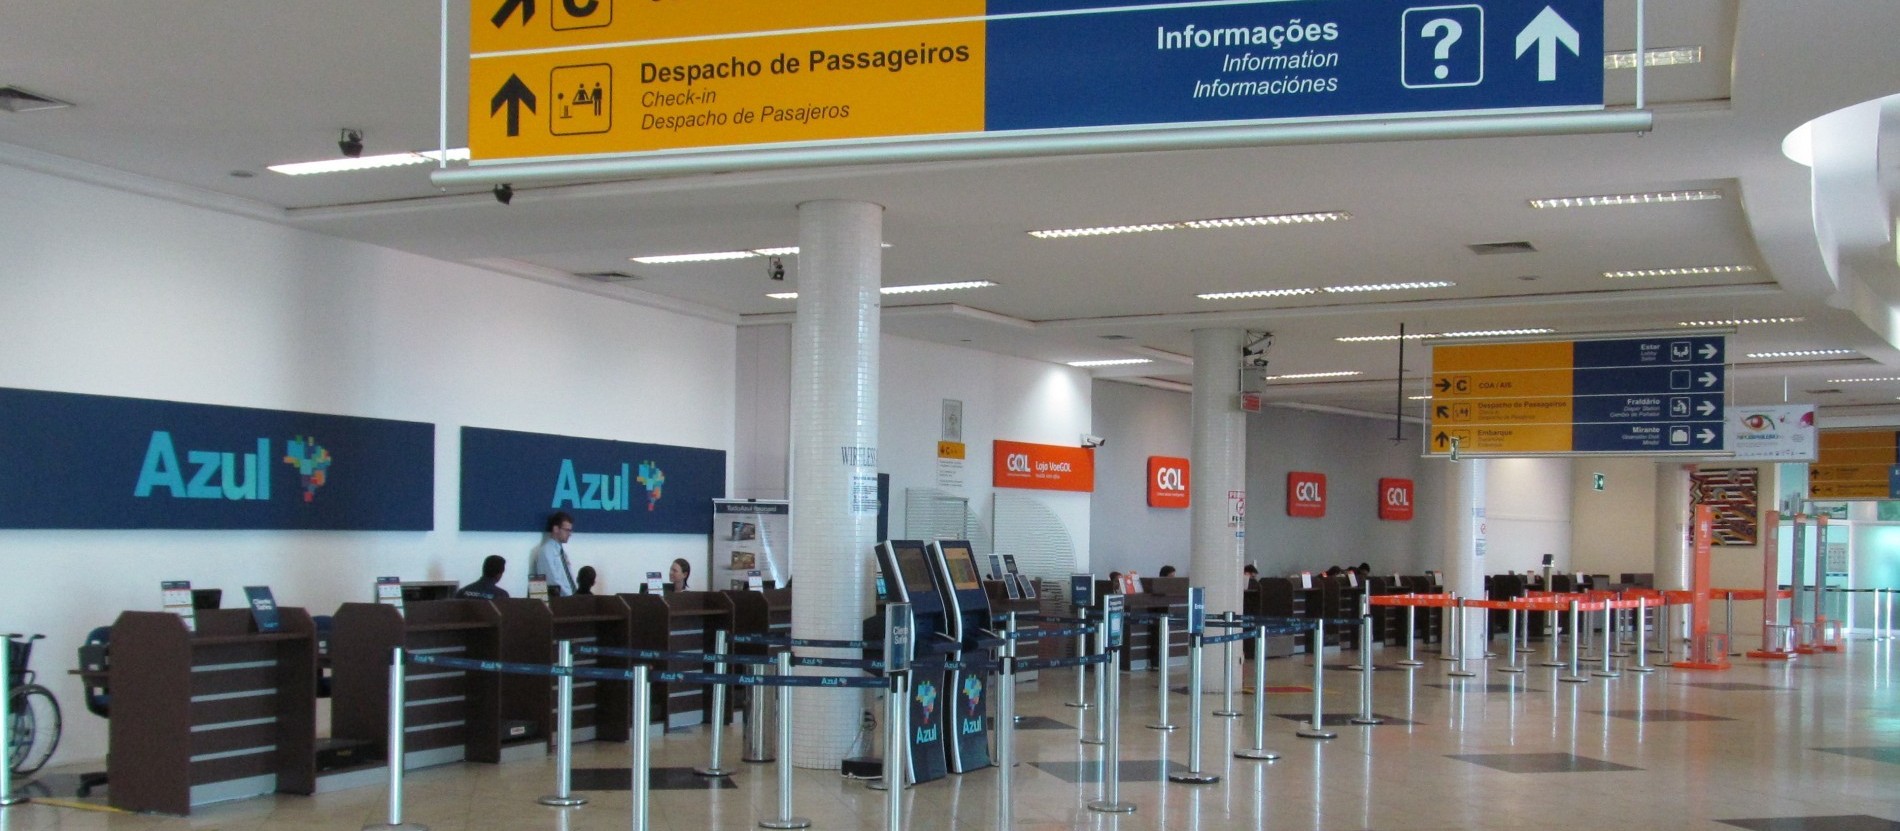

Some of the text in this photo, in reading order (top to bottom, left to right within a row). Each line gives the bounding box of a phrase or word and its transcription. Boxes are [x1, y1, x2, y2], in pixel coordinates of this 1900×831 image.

[1157, 18, 1339, 50] Informações
[640, 41, 970, 86] Despacho de Passageiros
[1222, 51, 1339, 73] Information
[1193, 75, 1339, 99] Informaciónes
[641, 88, 717, 108] Check-in
[641, 102, 850, 132] Despacho de Pasajeros
[1456, 380, 1467, 392] C
[1478, 402, 1512, 410] Despacho
[1523, 401, 1567, 409] Passageiros
[1478, 429, 1513, 437] Embarque
[134, 430, 270, 500] Azul
[1007, 453, 1031, 472] GOL
[1049, 461, 1072, 473] VoeGOL
[551, 458, 630, 511] Azul
[1157, 467, 1185, 491] GOL
[1296, 481, 1322, 502] GOL
[1387, 487, 1409, 506] GOL
[703, 653, 717, 661] Azul
[802, 657, 816, 665] Azul
[872, 660, 885, 668] Azu
[660, 672, 676, 681] Azul
[738, 675, 755, 684] Azul
[821, 677, 838, 686] Azul
[916, 723, 938, 745] Azul
[962, 715, 982, 735] Azul
